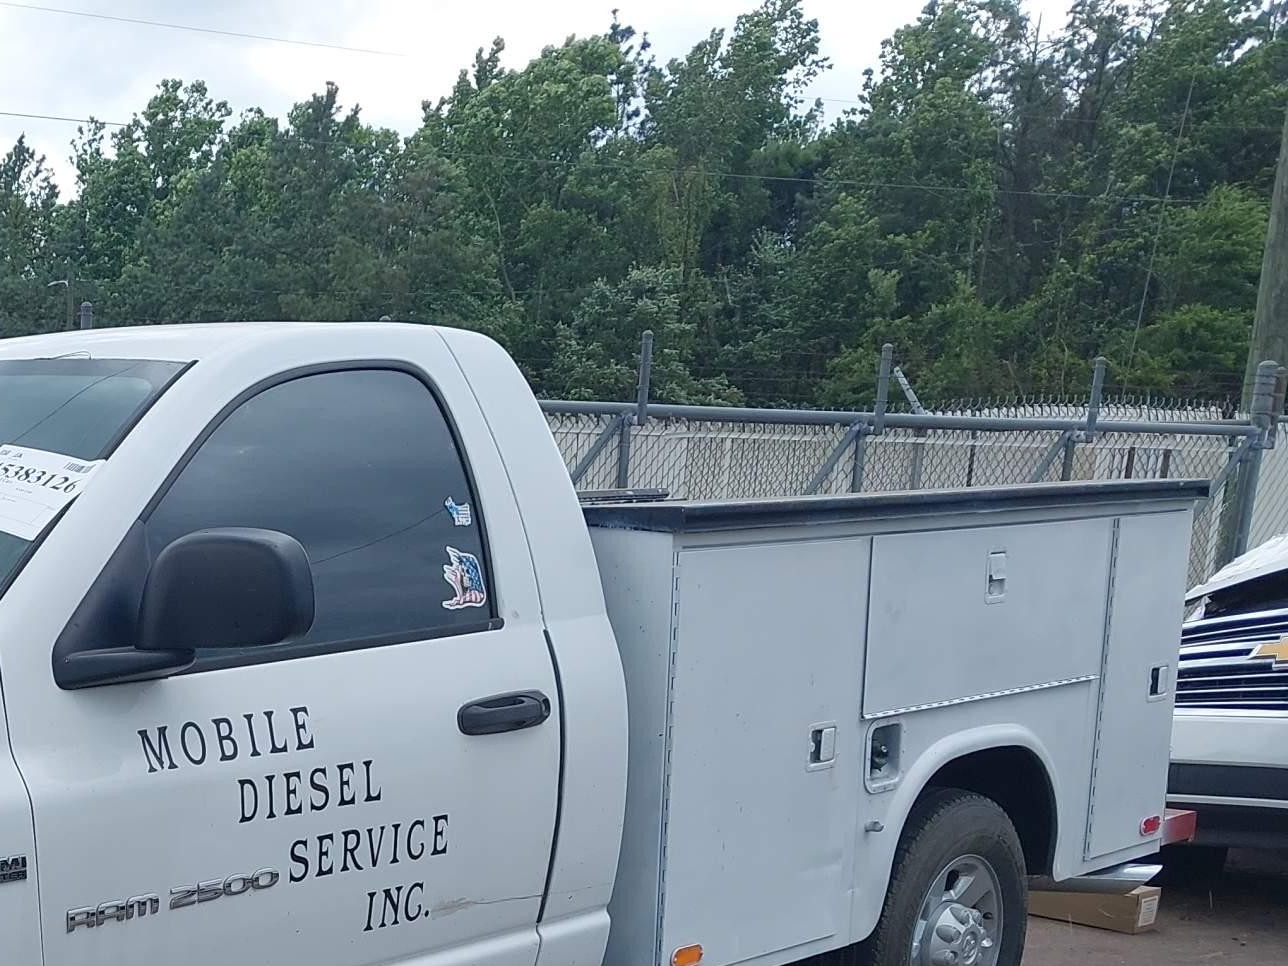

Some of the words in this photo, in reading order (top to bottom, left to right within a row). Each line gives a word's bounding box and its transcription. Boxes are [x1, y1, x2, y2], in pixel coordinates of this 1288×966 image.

[137, 706, 315, 773] MOBILE
[237, 759, 382, 824] DIESEL
[289, 814, 450, 884] SERVICE
[66, 893, 160, 933] RAM
[169, 867, 280, 910] 2500
[363, 881, 430, 932] INC.
